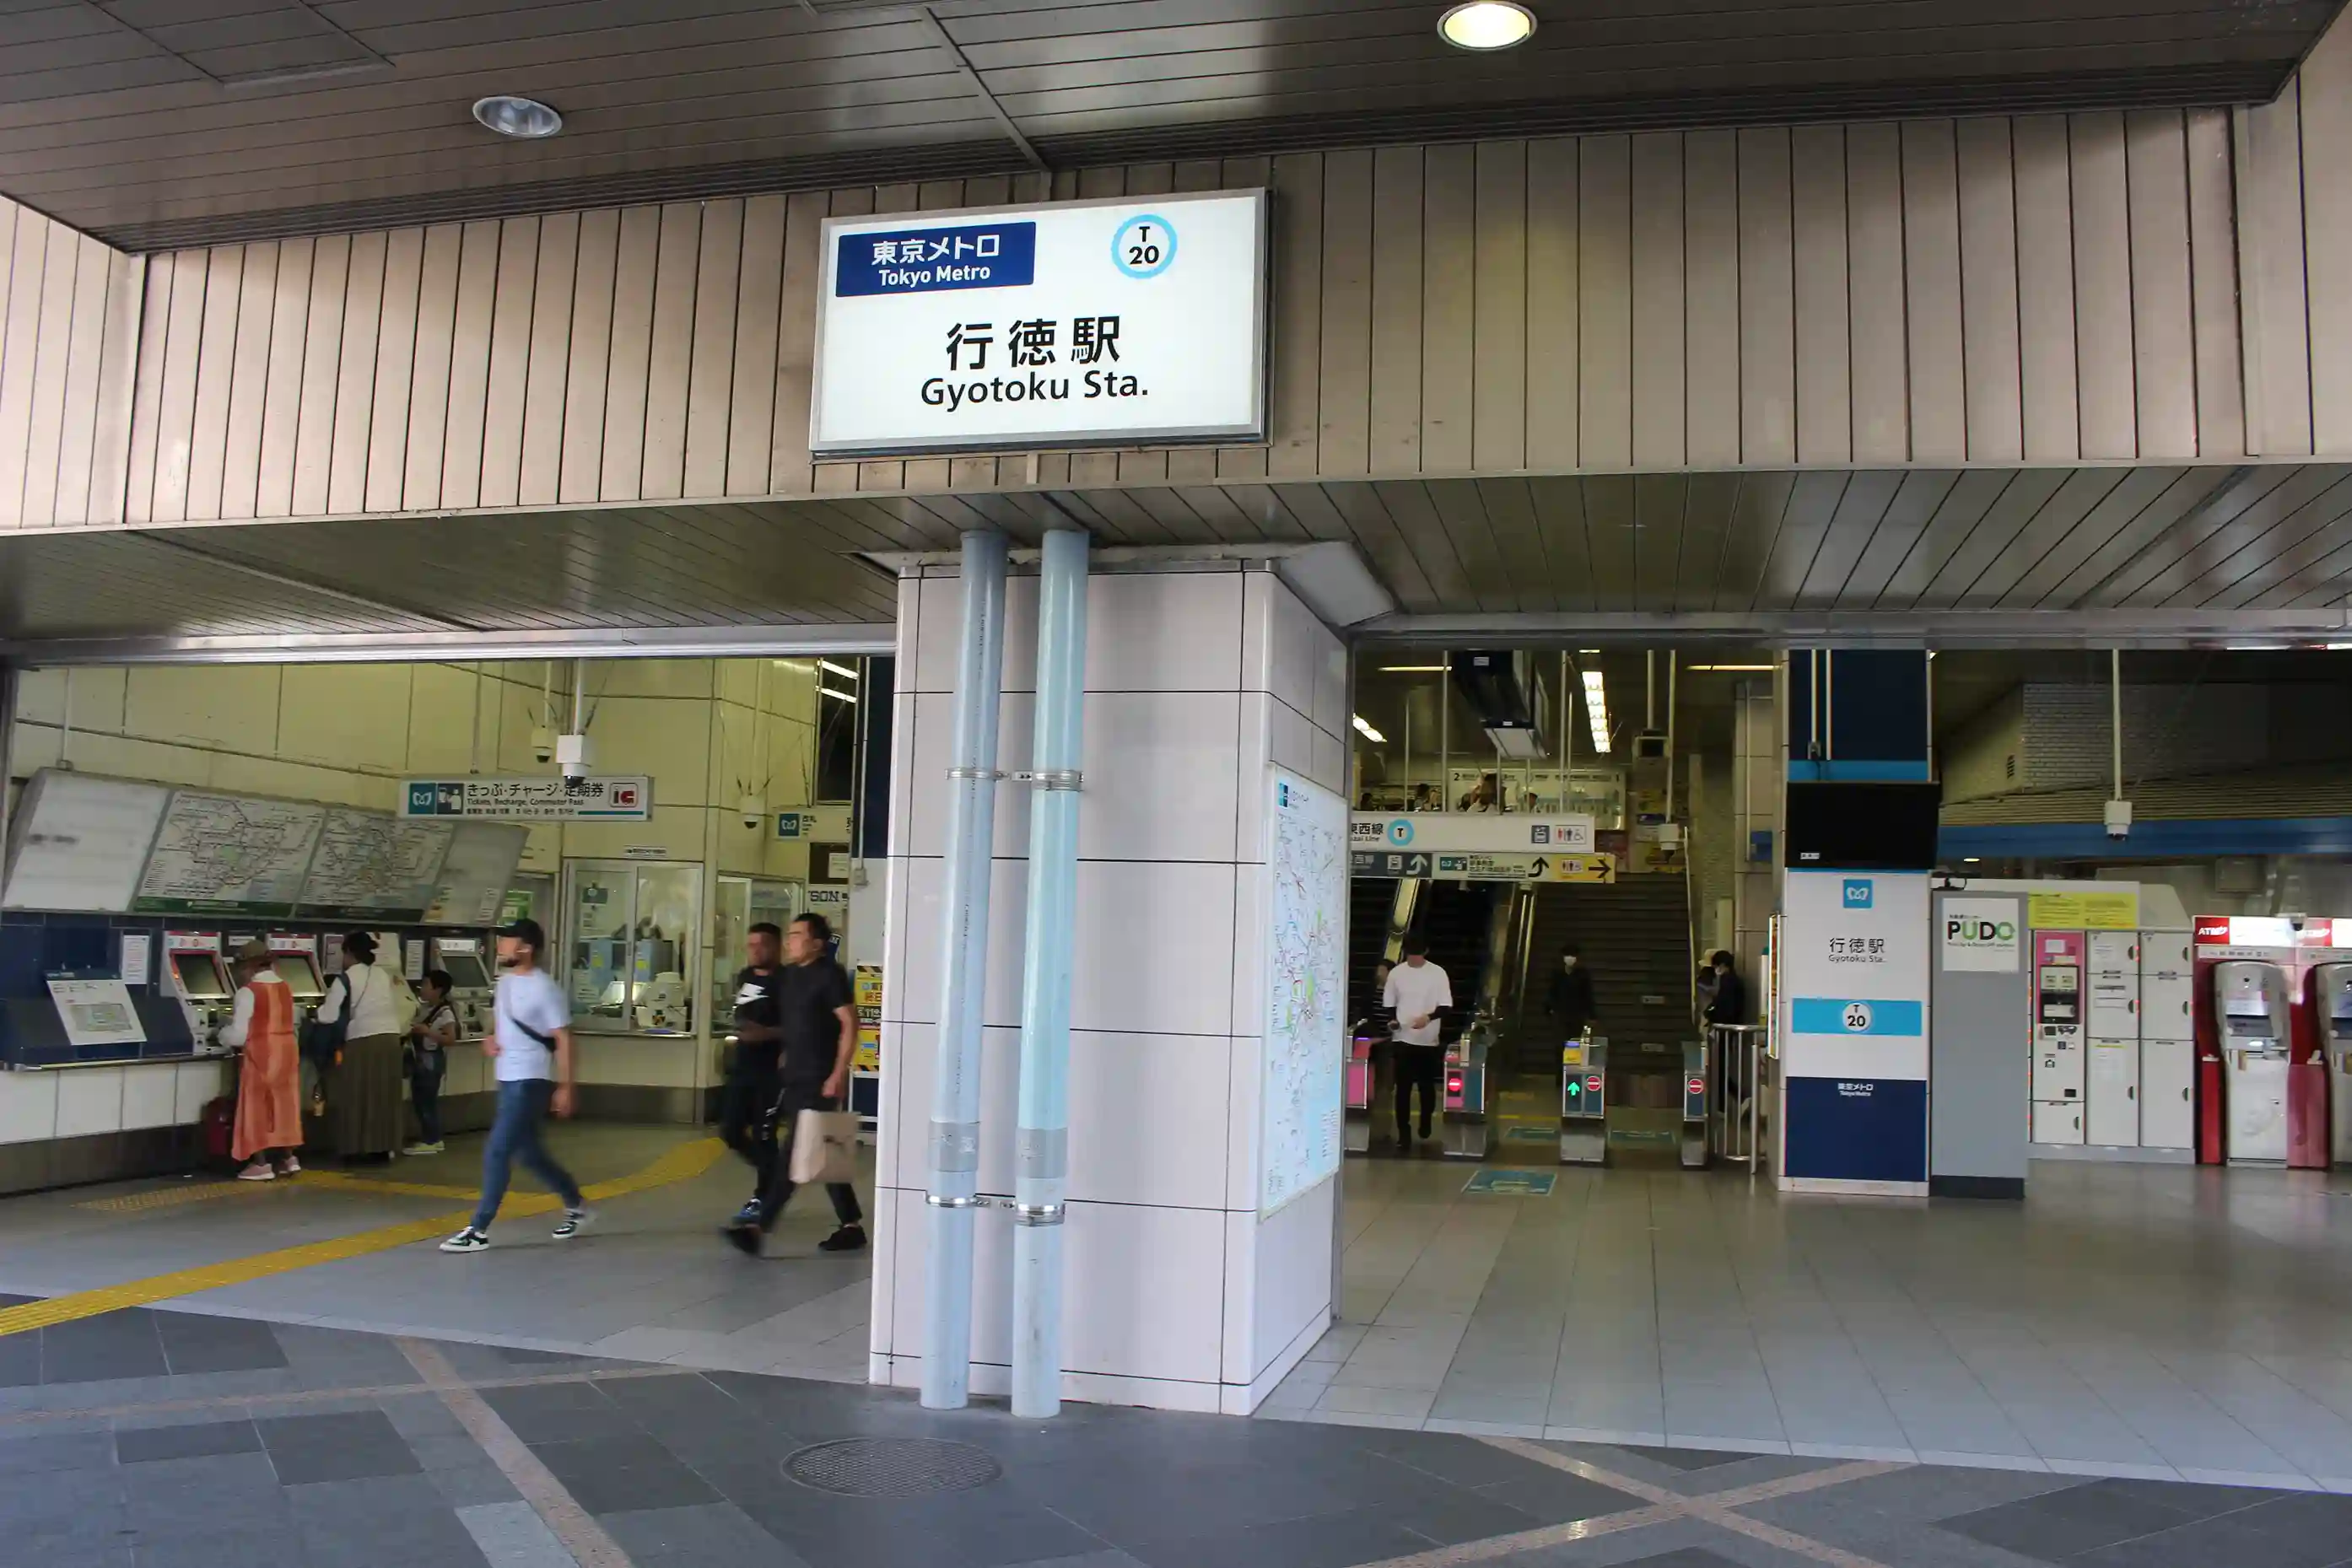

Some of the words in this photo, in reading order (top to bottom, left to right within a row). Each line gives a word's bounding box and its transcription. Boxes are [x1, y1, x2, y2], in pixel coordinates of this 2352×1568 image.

[1139, 226, 1151, 242] T
[871, 234, 1001, 266] 東京メトロ
[1128, 245, 1160, 266] 20
[878, 268, 931, 288] Tokyo
[936, 264, 991, 283] Metro
[946, 315, 1121, 372] 行徳駅
[920, 371, 1070, 412] Gyotoku
[1083, 369, 1149, 399] Sta.
[1397, 827, 1405, 838] T
[1947, 920, 2015, 940] PUDO
[1829, 937, 1885, 953] 行徳駅
[1828, 954, 1866, 963] Gyotoku
[1853, 1005, 1860, 1013] T
[1848, 1015, 1866, 1027] 20
